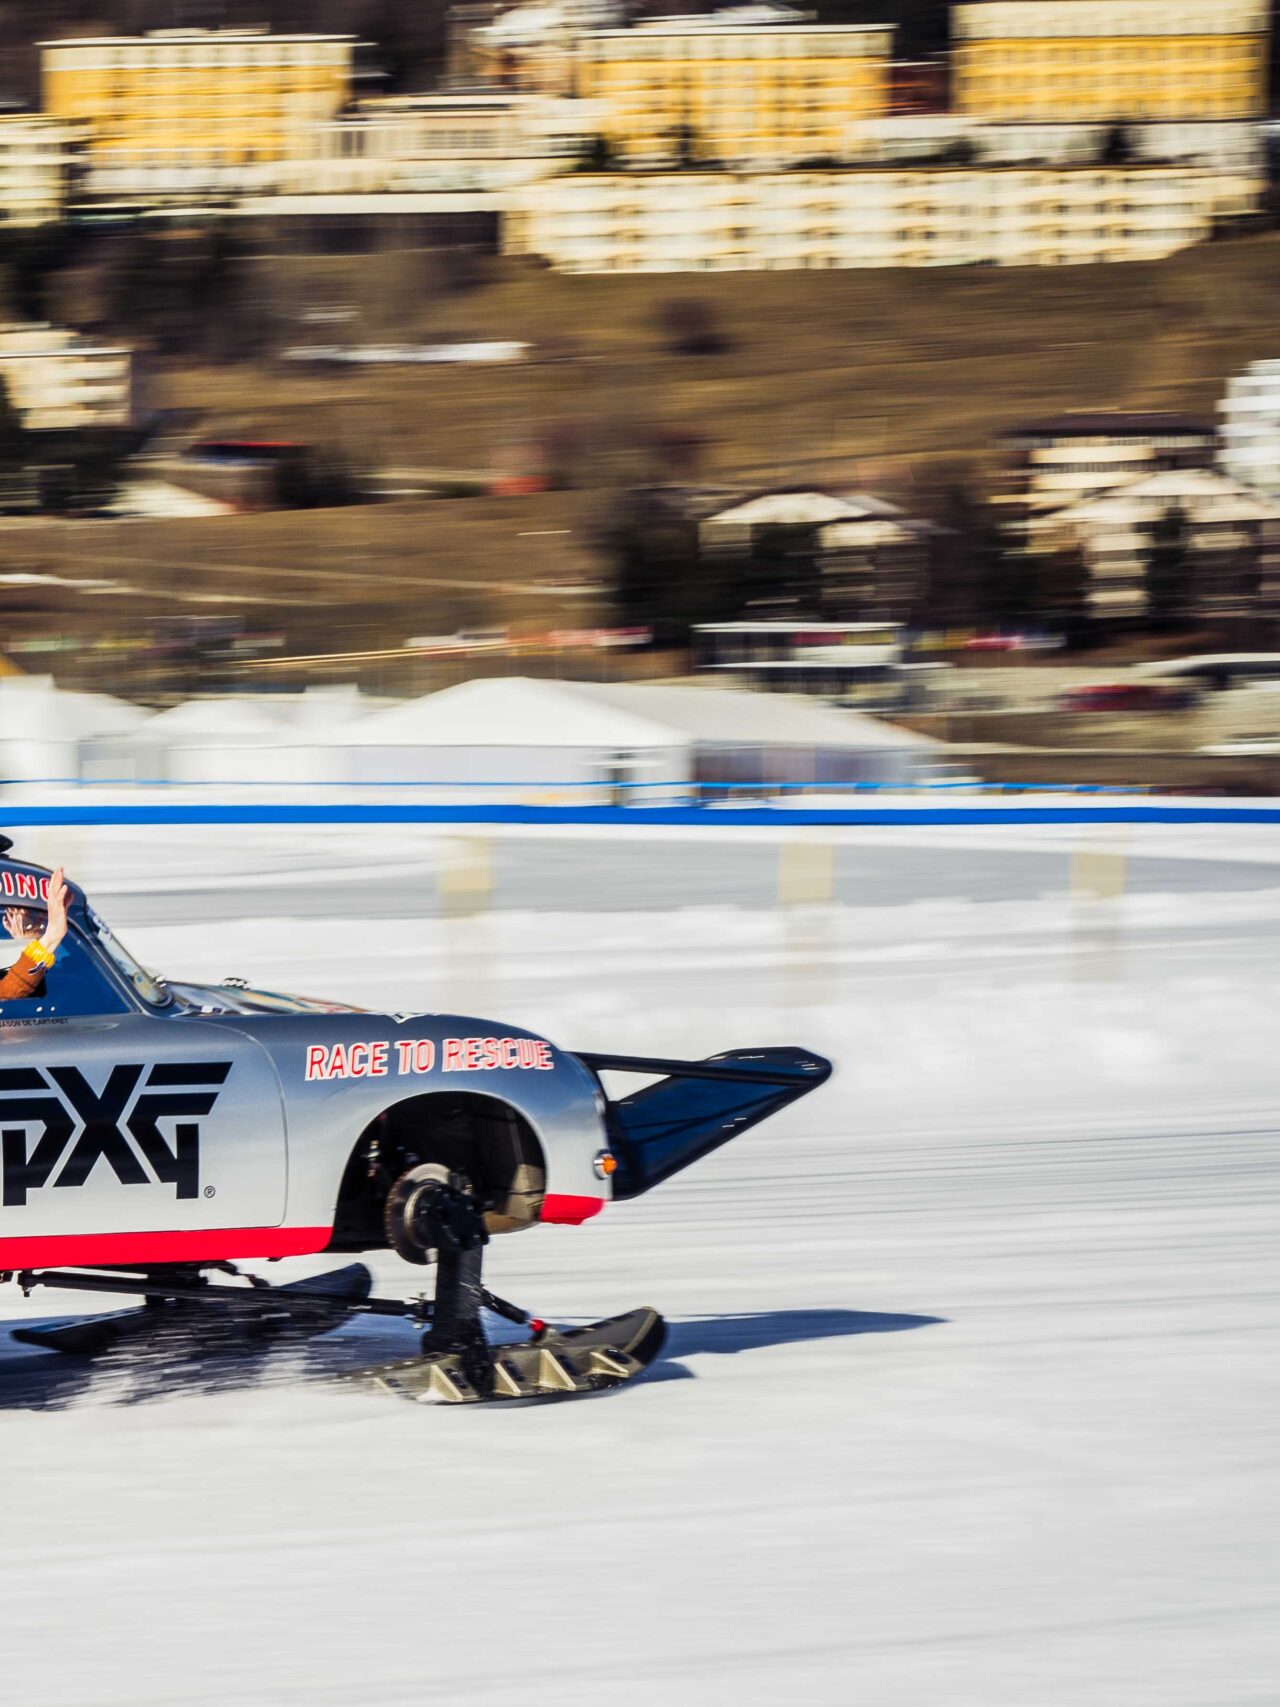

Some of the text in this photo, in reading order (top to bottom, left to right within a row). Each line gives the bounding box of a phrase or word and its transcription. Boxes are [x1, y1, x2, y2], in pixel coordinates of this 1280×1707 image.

[304, 1037, 555, 1081] RACE TO RESCUE
